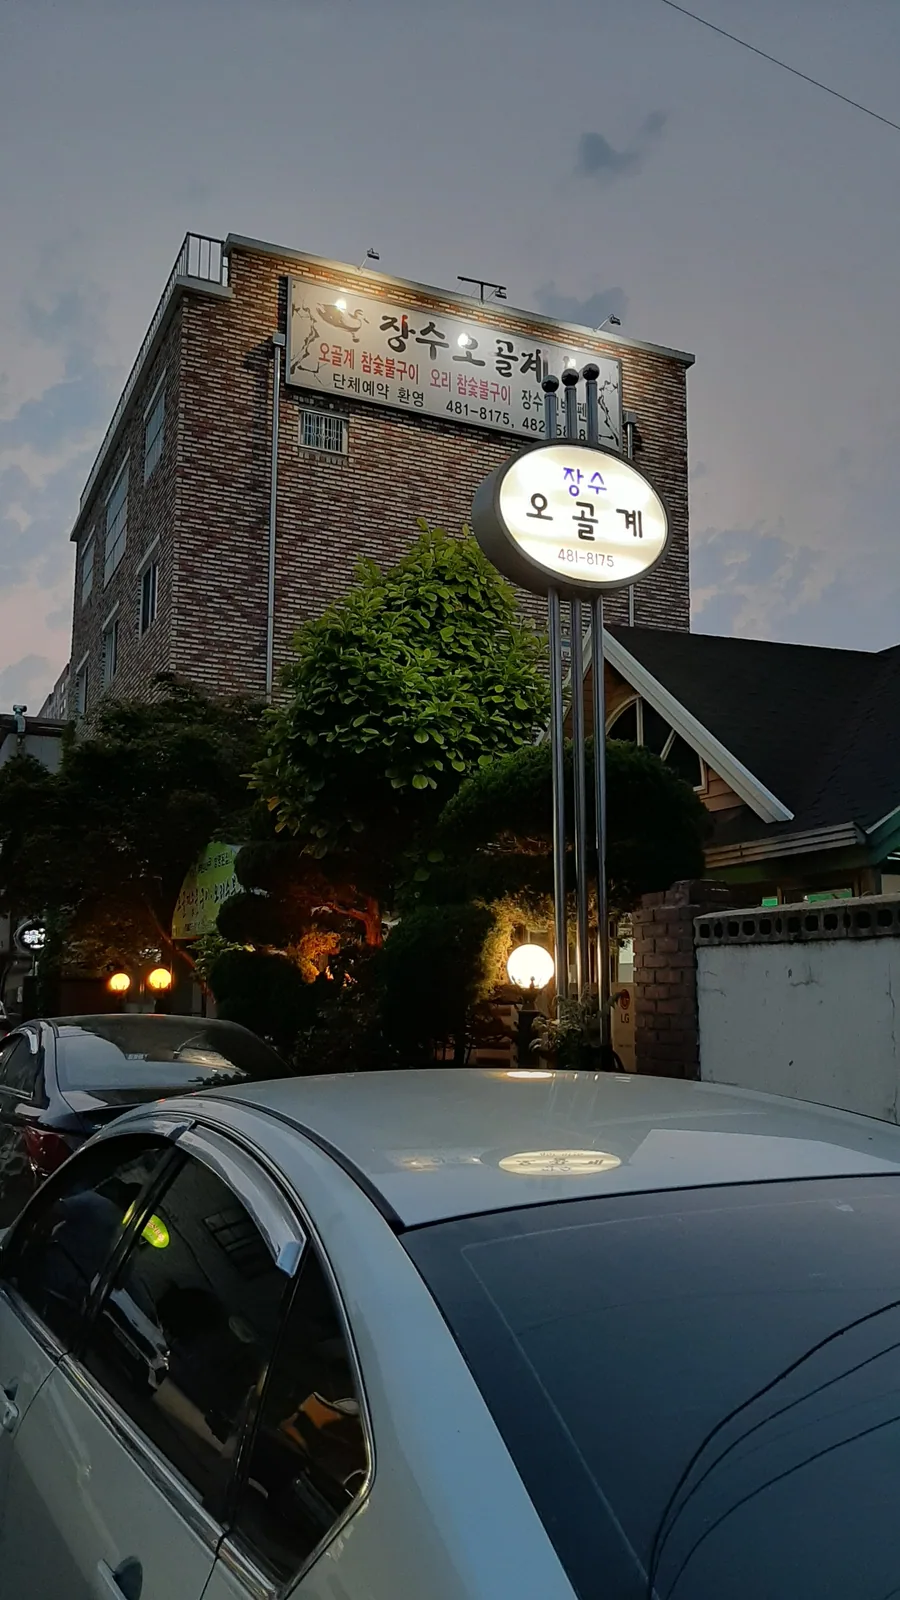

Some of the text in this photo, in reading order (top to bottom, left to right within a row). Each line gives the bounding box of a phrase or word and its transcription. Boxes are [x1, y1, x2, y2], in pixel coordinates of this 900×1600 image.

[318, 342, 355, 370] 오골계
[360, 351, 419, 385] 참숯불구이
[430, 368, 452, 393] 오리
[456, 373, 511, 406] 참숯불구이
[332, 373, 425, 408] 단체예약 환영
[562, 467, 607, 497] 장수
[526, 493, 643, 541] 오골계
[557, 548, 615, 568] 481-8175
[620, 1013, 629, 1023] LG
